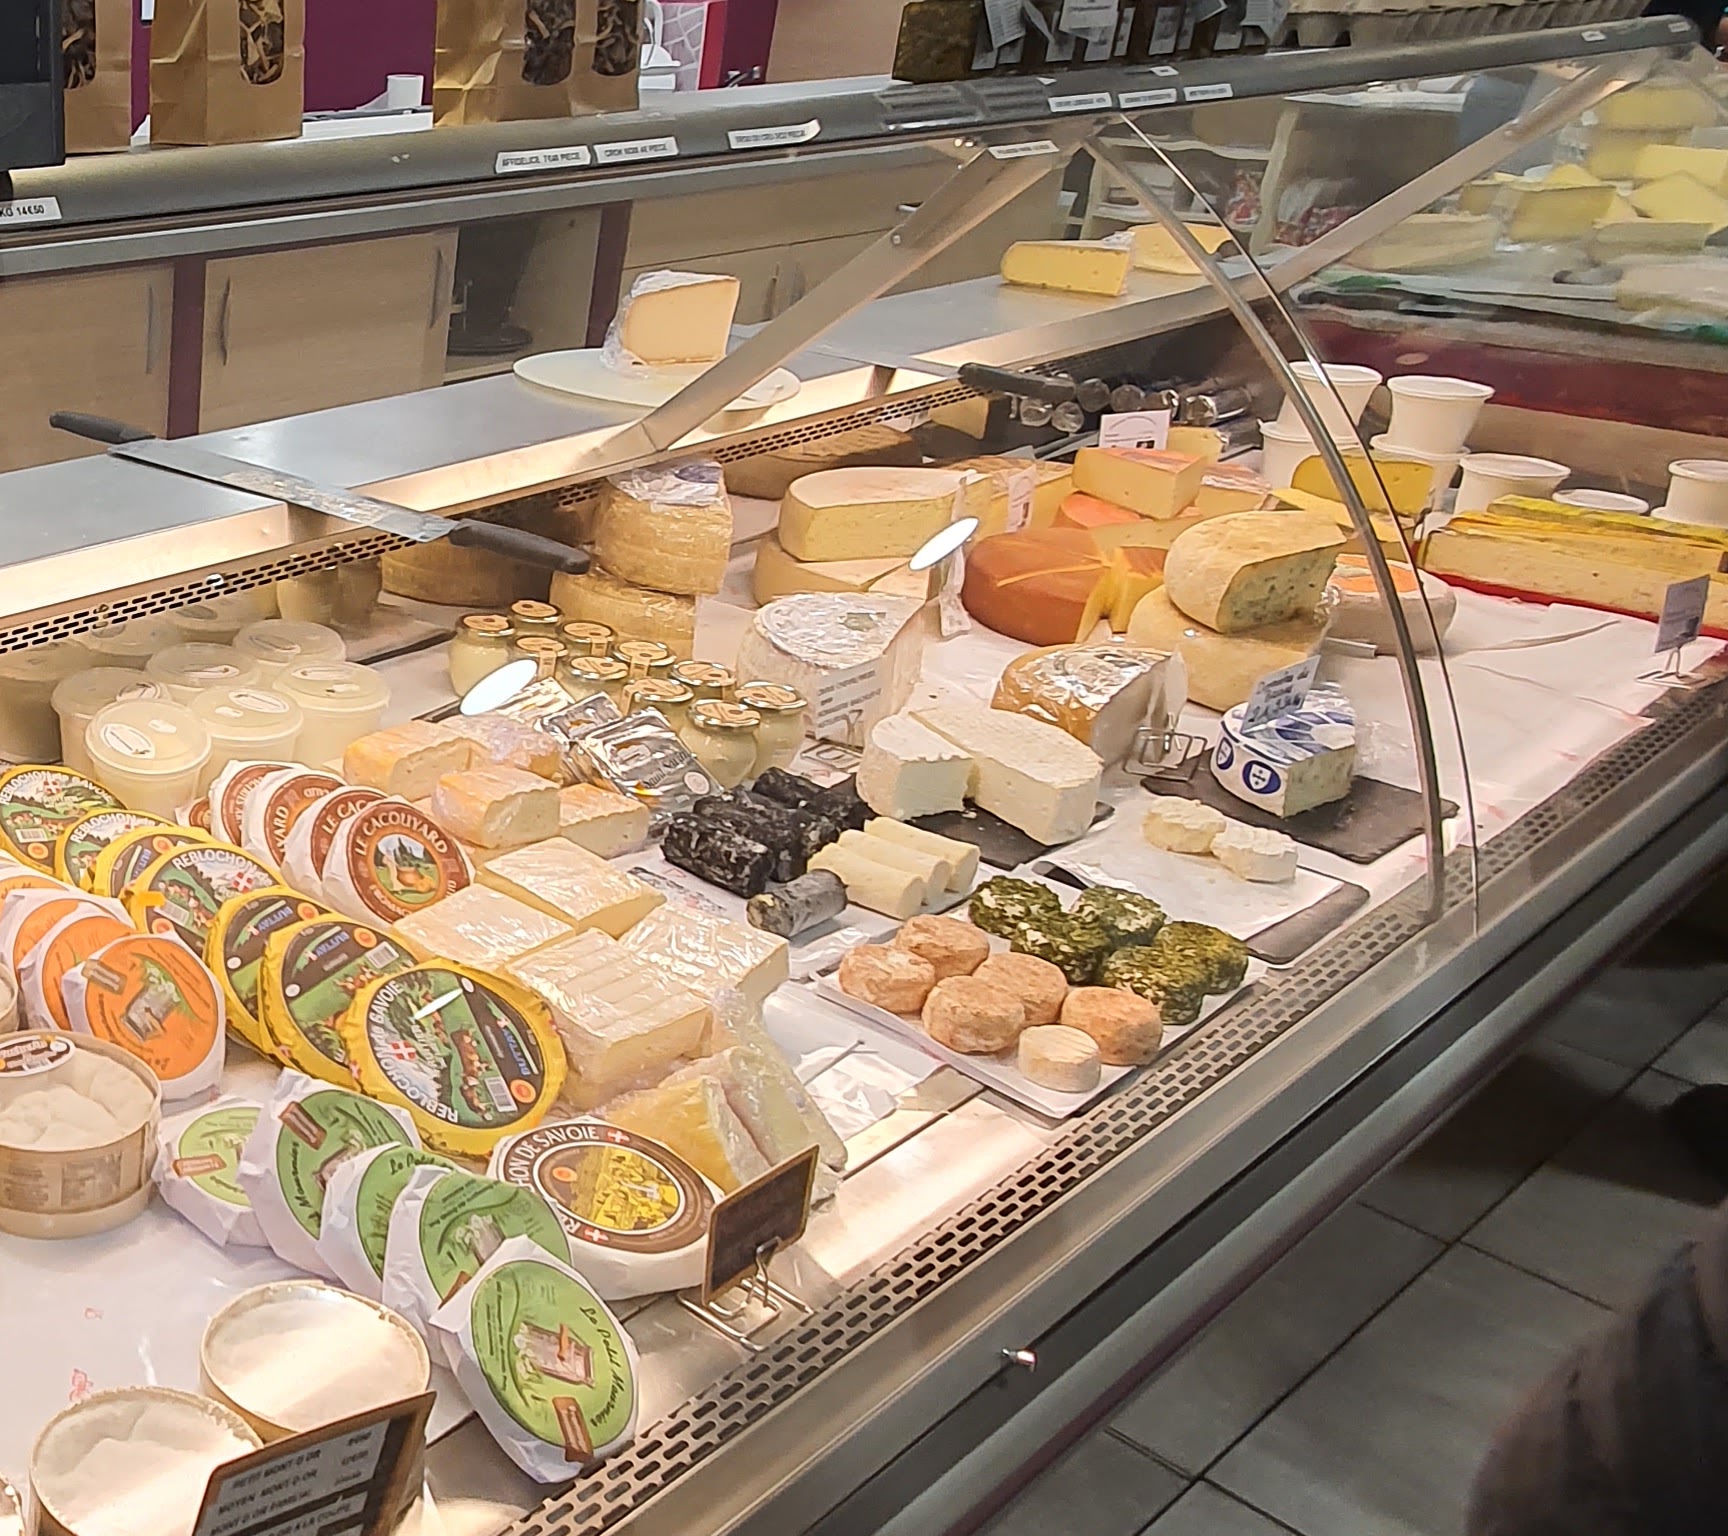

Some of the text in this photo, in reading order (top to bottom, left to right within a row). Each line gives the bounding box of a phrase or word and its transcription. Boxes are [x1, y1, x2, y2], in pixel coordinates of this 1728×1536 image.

[71, 775, 114, 803] SAVOIE
[70, 812, 137, 843] REBLOCHON
[322, 814, 339, 835] LE
[354, 811, 448, 856] LE CACOUYARD
[171, 848, 259, 872] REBLOCHON
[368, 980, 404, 1026] SAVOIE
[503, 1028, 532, 1077] BUTTAY
[373, 1039, 459, 1124] REBLOCHON
[519, 1139, 541, 1157] DE
[534, 1126, 600, 1147] SAVOIE
[579, 1306, 598, 1327] Le
[596, 1327, 622, 1370] Petit
[217, 1492, 257, 1515] MOYEN
